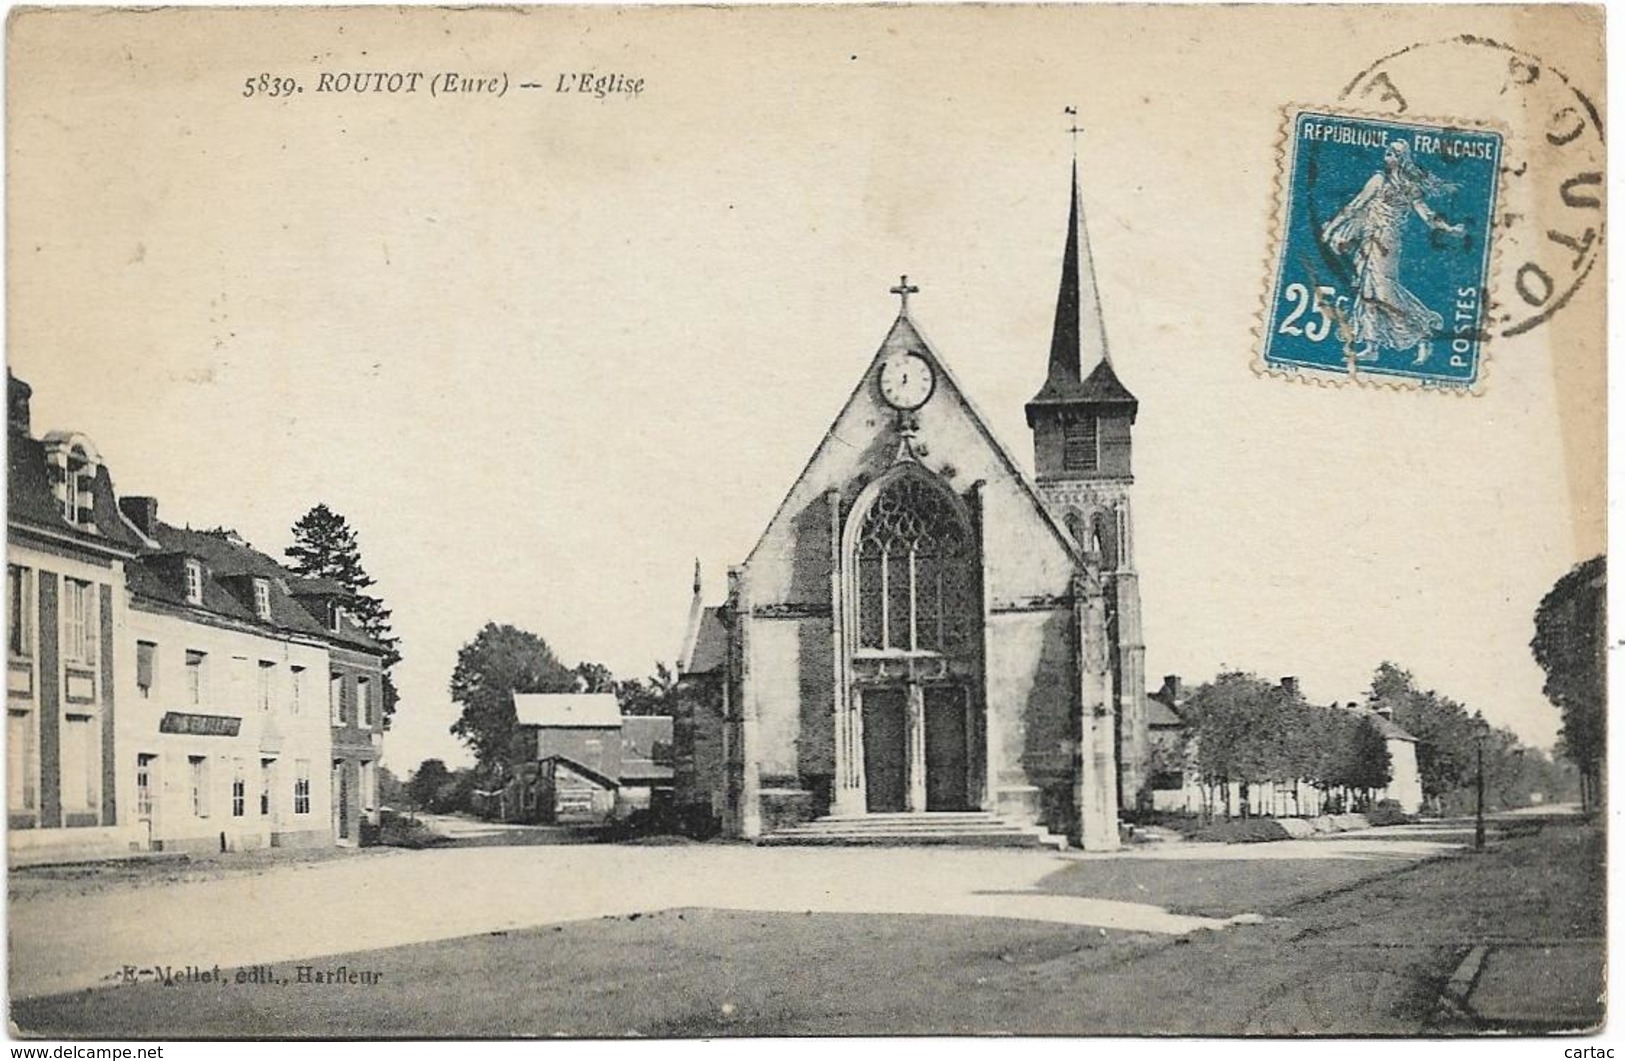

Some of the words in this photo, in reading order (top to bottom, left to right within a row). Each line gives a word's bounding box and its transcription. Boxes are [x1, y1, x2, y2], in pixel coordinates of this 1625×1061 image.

[242, 72, 304, 98] 5839.
[316, 72, 424, 94] ROUTOT
[430, 72, 509, 98] (Eure)
[1449, 287, 1477, 367] POSTES
[295, 966, 383, 985] Harfleur
